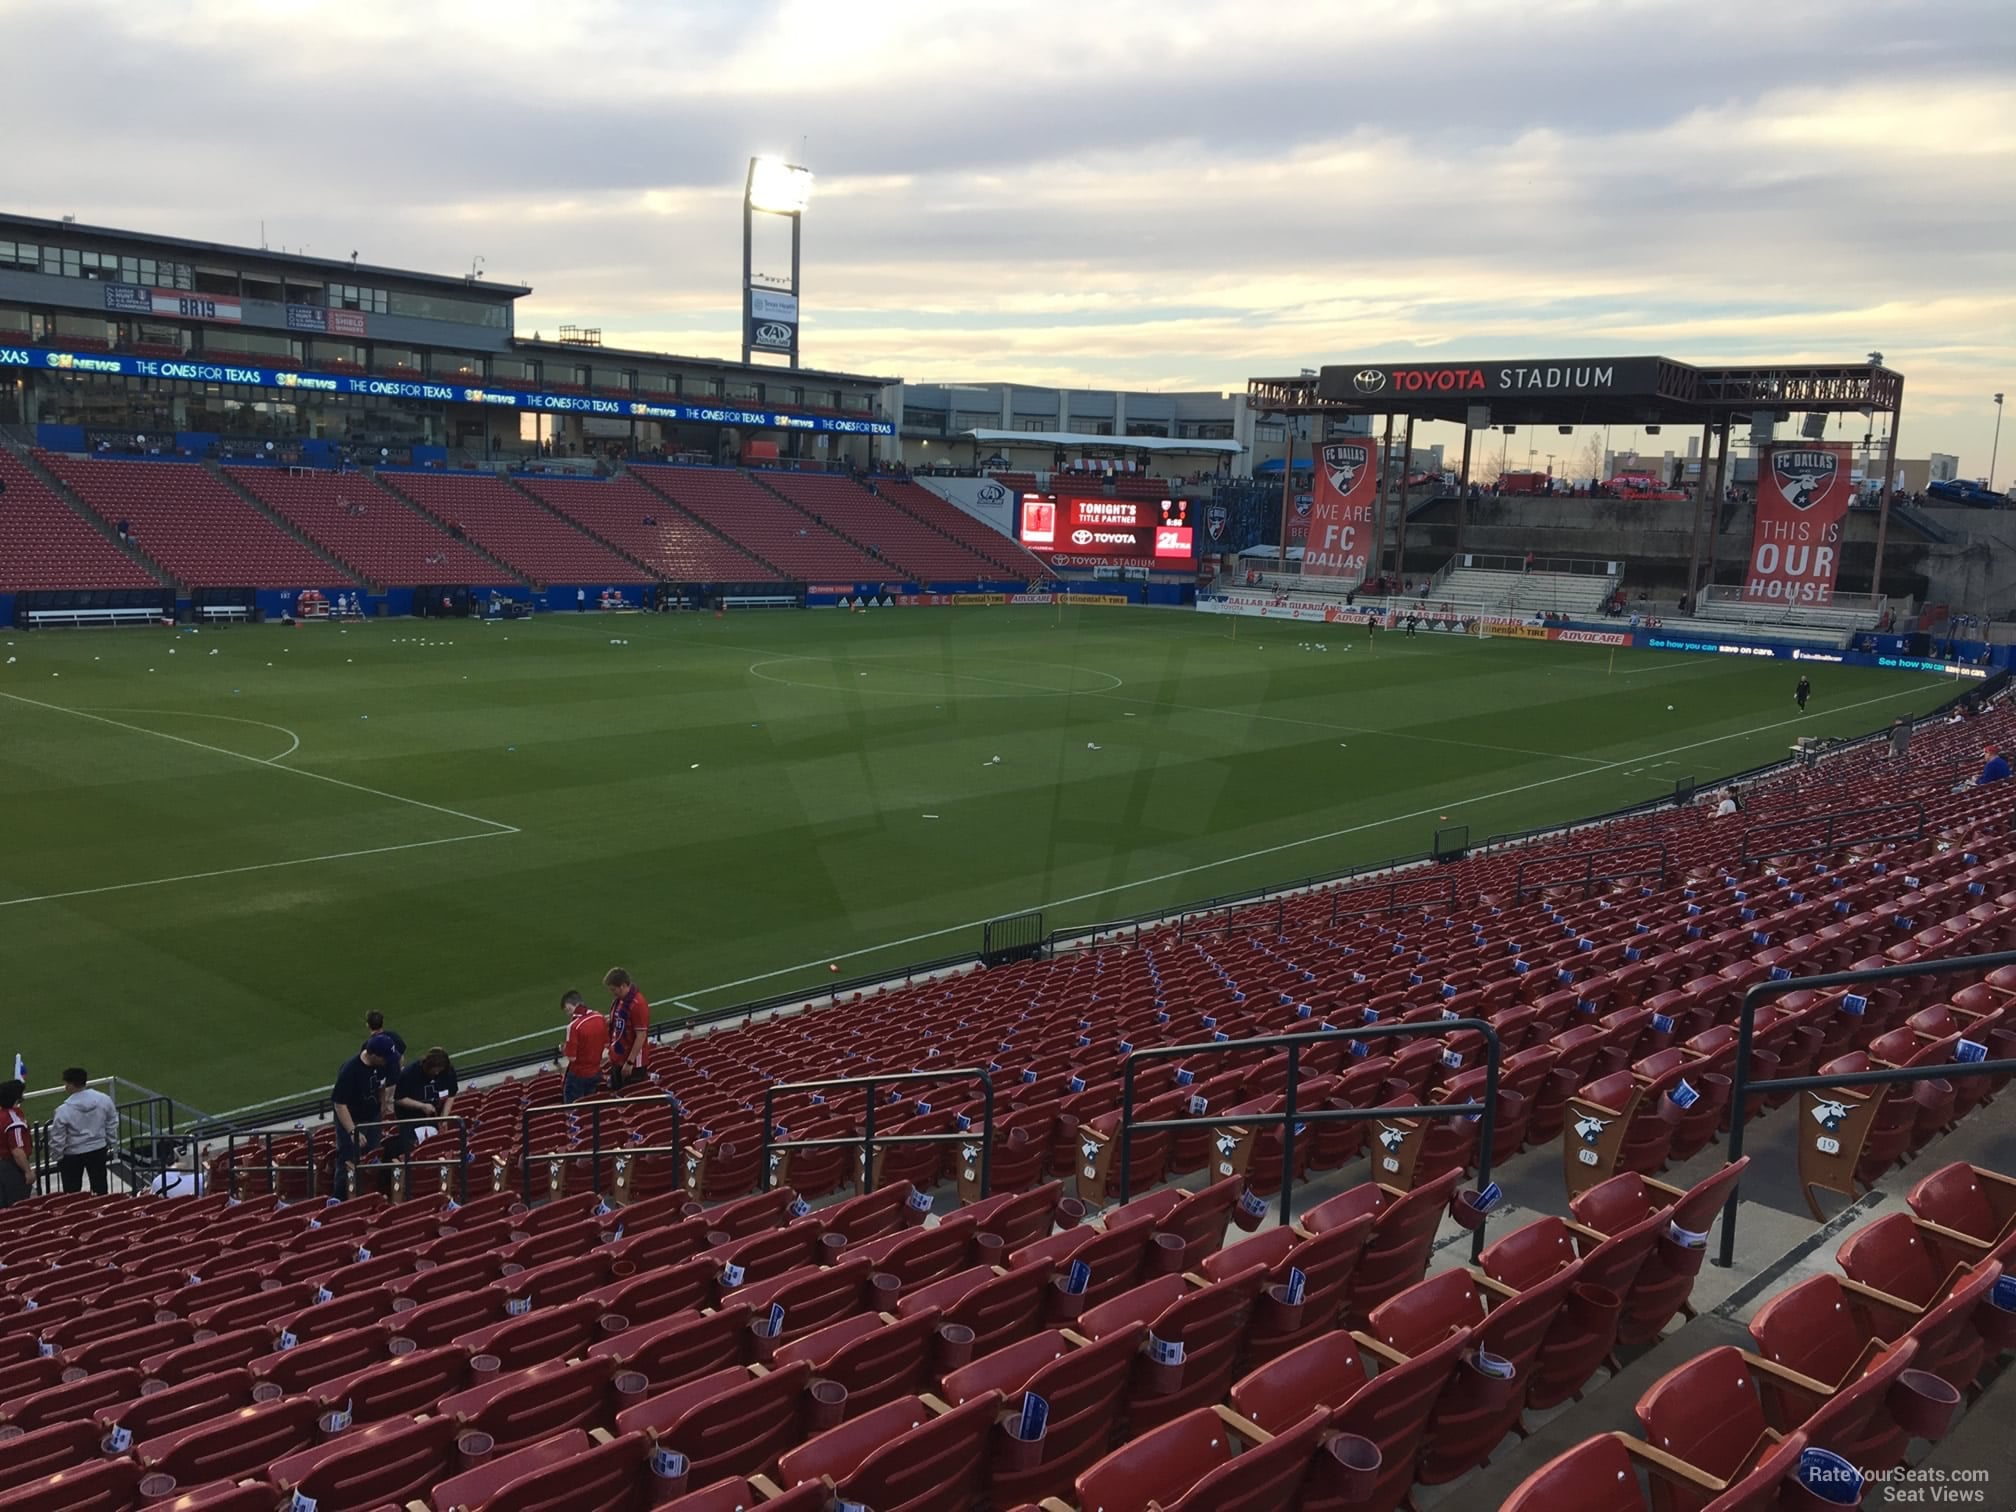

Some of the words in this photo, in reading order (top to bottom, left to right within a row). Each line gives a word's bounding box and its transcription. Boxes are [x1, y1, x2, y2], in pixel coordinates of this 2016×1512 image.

[179, 298, 215, 318] BR19
[336, 318, 363, 327] SHIELD
[0, 349, 29, 364] XAS
[135, 361, 158, 375] THE
[161, 363, 197, 378] ONES
[198, 366, 222, 380] FOR
[224, 368, 260, 383] TEXAS
[1392, 369, 1485, 392] TOYOTA
[1499, 366, 1614, 389] STADIUM
[349, 379, 367, 392] THE
[369, 381, 400, 395] ONES
[400, 384, 421, 397] FOR
[422, 385, 452, 399] TEXAS
[526, 394, 543, 407] THE
[544, 396, 572, 409] ONES
[571, 398, 591, 410] FOR
[592, 400, 619, 413] TEXAS
[686, 408, 699, 419] THE
[701, 409, 725, 421] ONES
[724, 411, 742, 423] FOR
[741, 412, 765, 424] TEXAS
[822, 419, 835, 430] THE
[835, 420, 856, 431] ONES
[855, 422, 871, 433] FOR
[870, 423, 891, 434] TEXAS
[1326, 448, 1335, 460] FC
[1338, 448, 1365, 462] DALLAS
[1777, 454, 1790, 469] FC
[1794, 453, 1833, 469] DALLAS
[1079, 502, 1137, 516] TONIGHT'S
[1316, 504, 1339, 520] WE
[1343, 505, 1373, 522] ARE
[1079, 514, 1100, 523] TITLE
[1101, 515, 1136, 524] PARTNER
[1093, 533, 1136, 544] TOYOTA
[1324, 525, 1356, 551] FC
[1761, 520, 1810, 541] THIS
[1820, 522, 1839, 543] IS
[1070, 556, 1108, 566] TOYOTA
[1112, 558, 1156, 568] STADIUM
[1306, 551, 1365, 569] DALLAS
[1755, 543, 1834, 577] OUR
[1748, 578, 1830, 602] HOUSE
[1527, 629, 1546, 637] TIRE
[1559, 630, 1624, 644] ADVOCARE
[1649, 638, 1665, 648] See
[1666, 639, 1683, 649] how
[1684, 642, 1700, 651] you
[1701, 643, 1717, 651] can
[1718, 645, 1739, 654] save
[1753, 647, 1775, 656] care.
[1878, 657, 1897, 667] See
[1898, 658, 1920, 669] how
[1920, 662, 1934, 671] you
[1933, 663, 1945, 671] can
[1822, 1140, 1836, 1151] 19
[1386, 1159, 1397, 1169] 17
[1582, 1151, 1595, 1162] 18
[1222, 1164, 1231, 1173] 16
